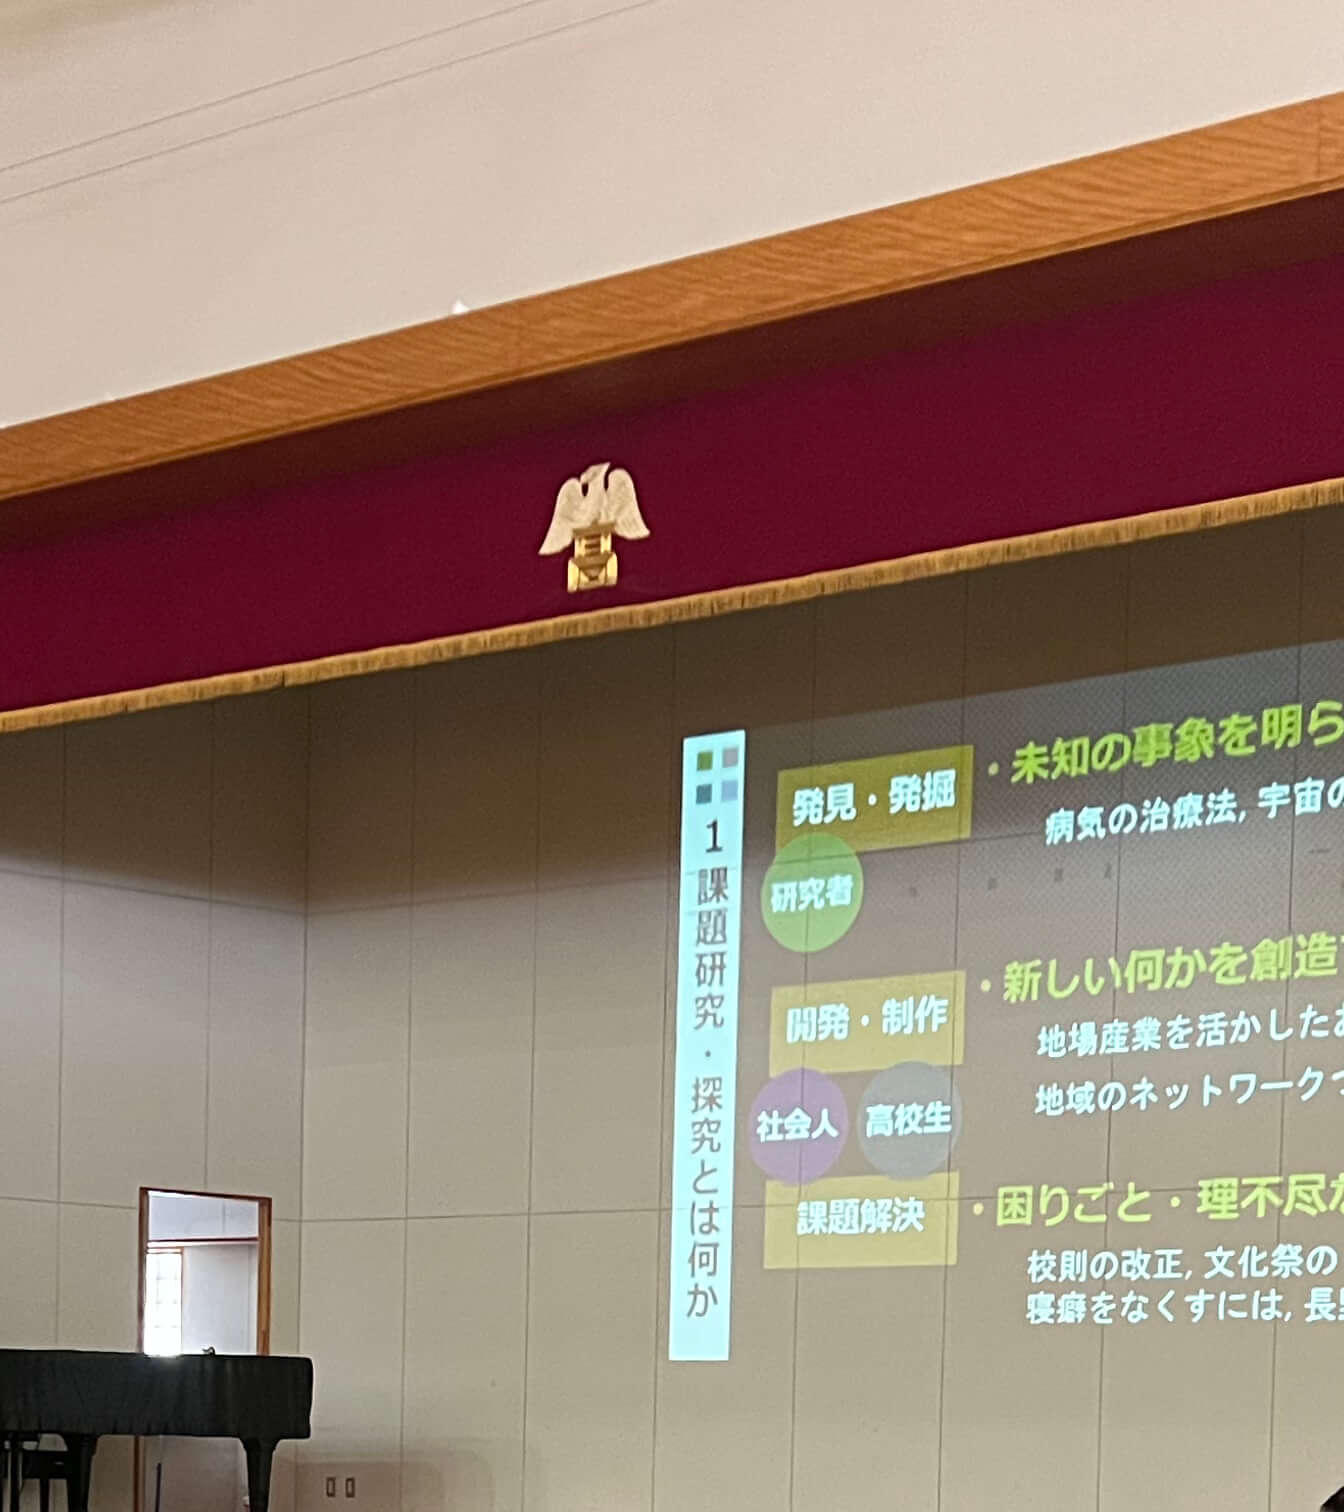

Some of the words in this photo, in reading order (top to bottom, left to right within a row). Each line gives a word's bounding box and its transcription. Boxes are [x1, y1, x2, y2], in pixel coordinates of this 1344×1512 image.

[792, 769, 958, 826] 発見・発掘
[770, 873, 853, 913] 研究者
[786, 996, 949, 1044] 開発・制作
[756, 1110, 840, 1143] 社会人
[865, 1100, 953, 1137] 高校生
[796, 1197, 926, 1235] 課題解決
